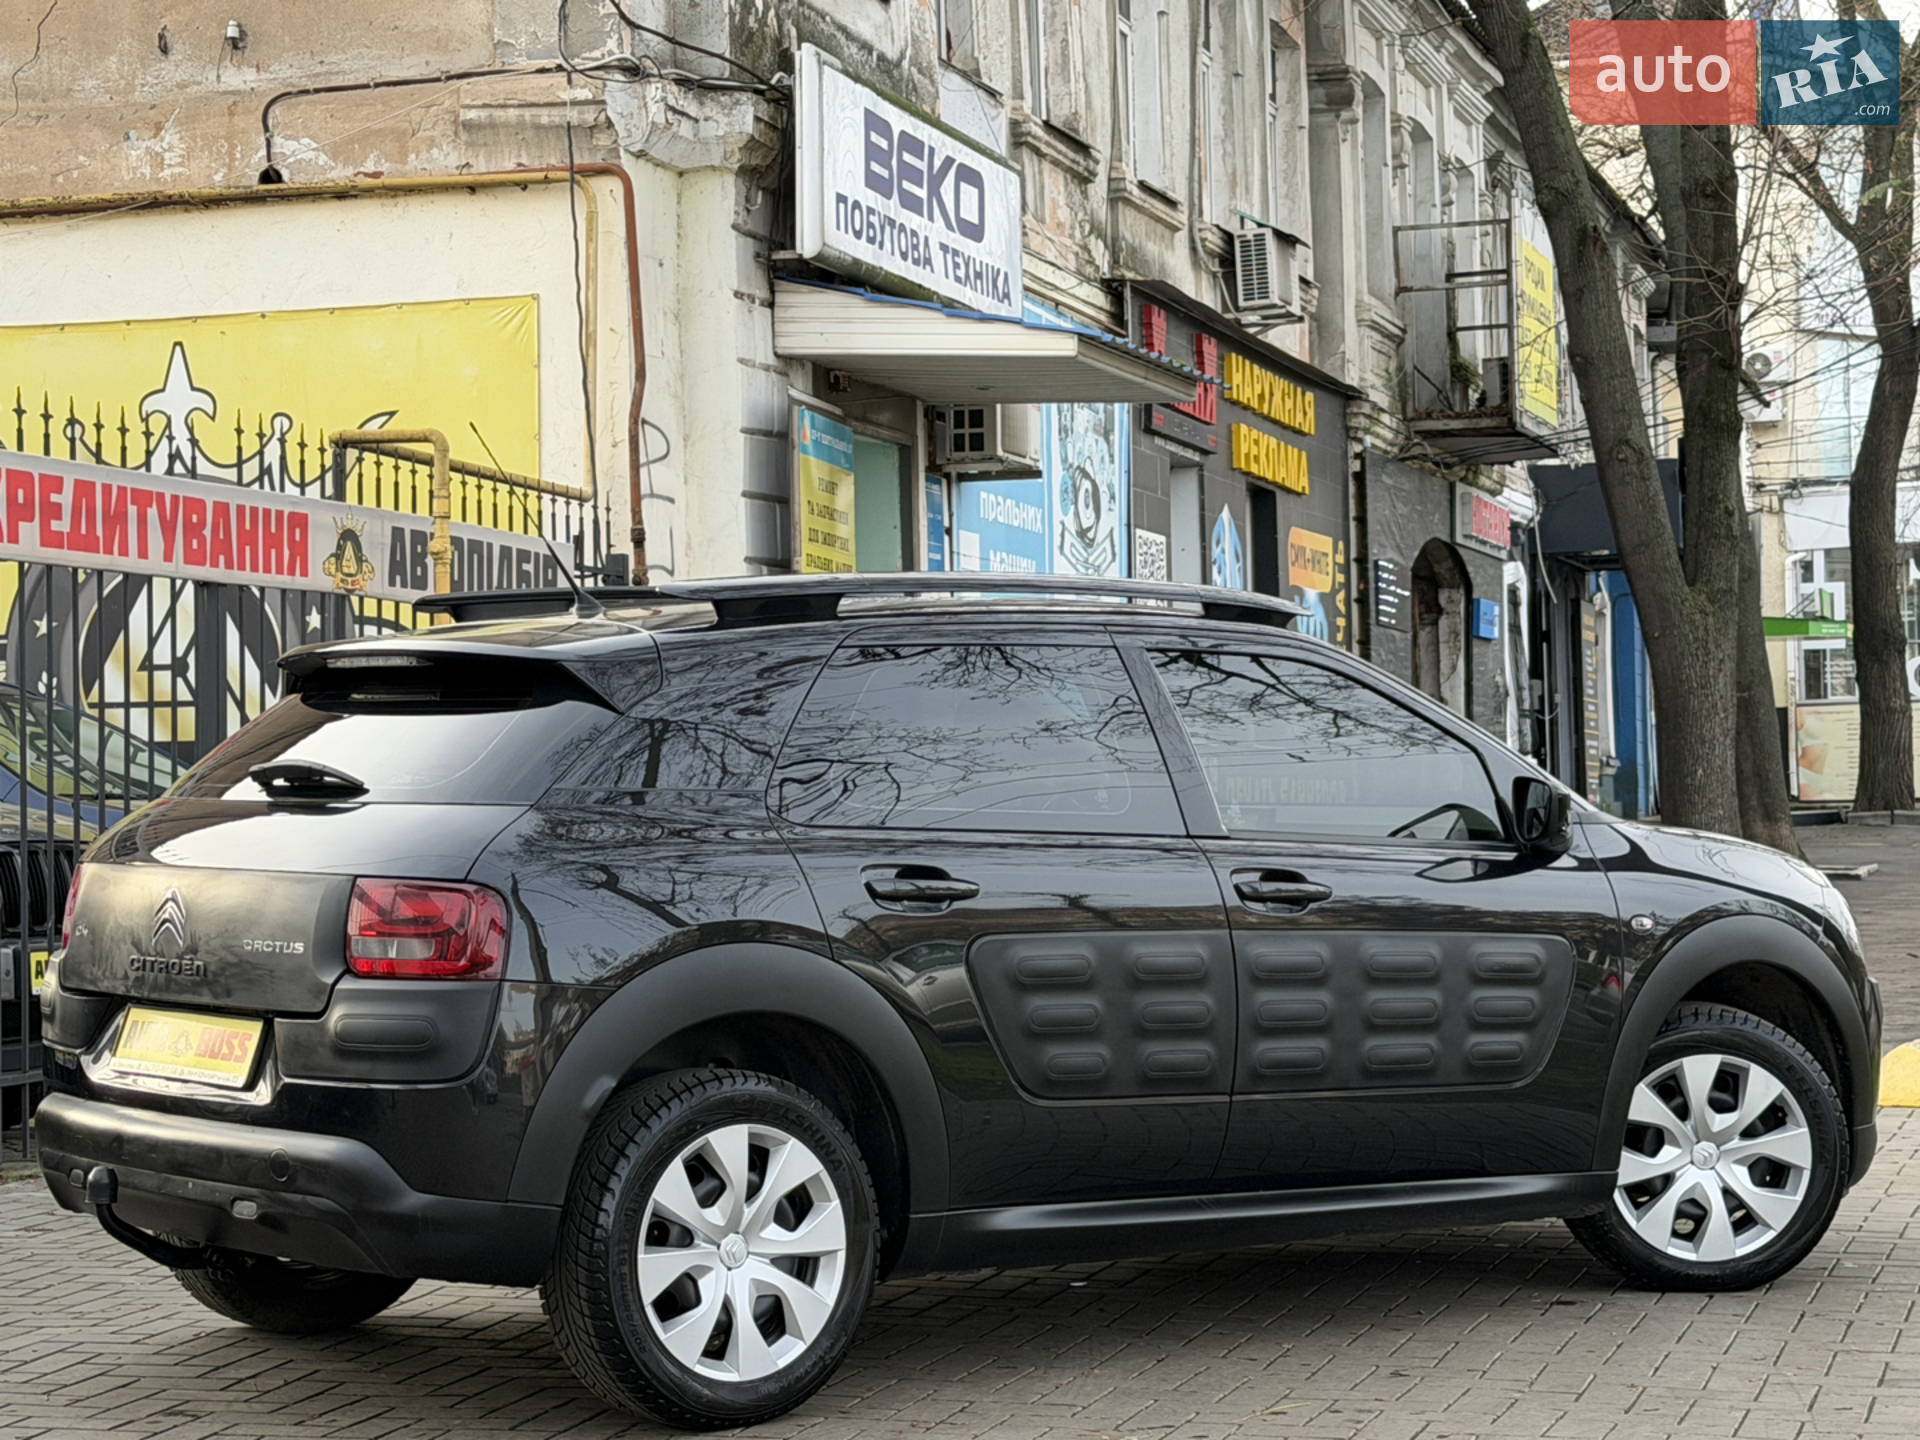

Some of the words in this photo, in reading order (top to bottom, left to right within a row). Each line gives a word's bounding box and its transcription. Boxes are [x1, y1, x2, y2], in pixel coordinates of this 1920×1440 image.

[864, 106, 985, 244] BEKO
[836, 191, 935, 274] ПОБУТОВА
[938, 241, 1012, 307] ТЕХНІКА
[1226, 352, 1316, 436] НАРУЖНАЯ
[1234, 422, 1310, 496] РЕКЛАМА
[0, 466, 310, 578] РЕДИТУВАННЯ
[980, 490, 1043, 534] пральних
[388, 525, 558, 593] АВОПІДБІР
[243, 939, 304, 954] CACTUS
[194, 1027, 253, 1064] BOSS
